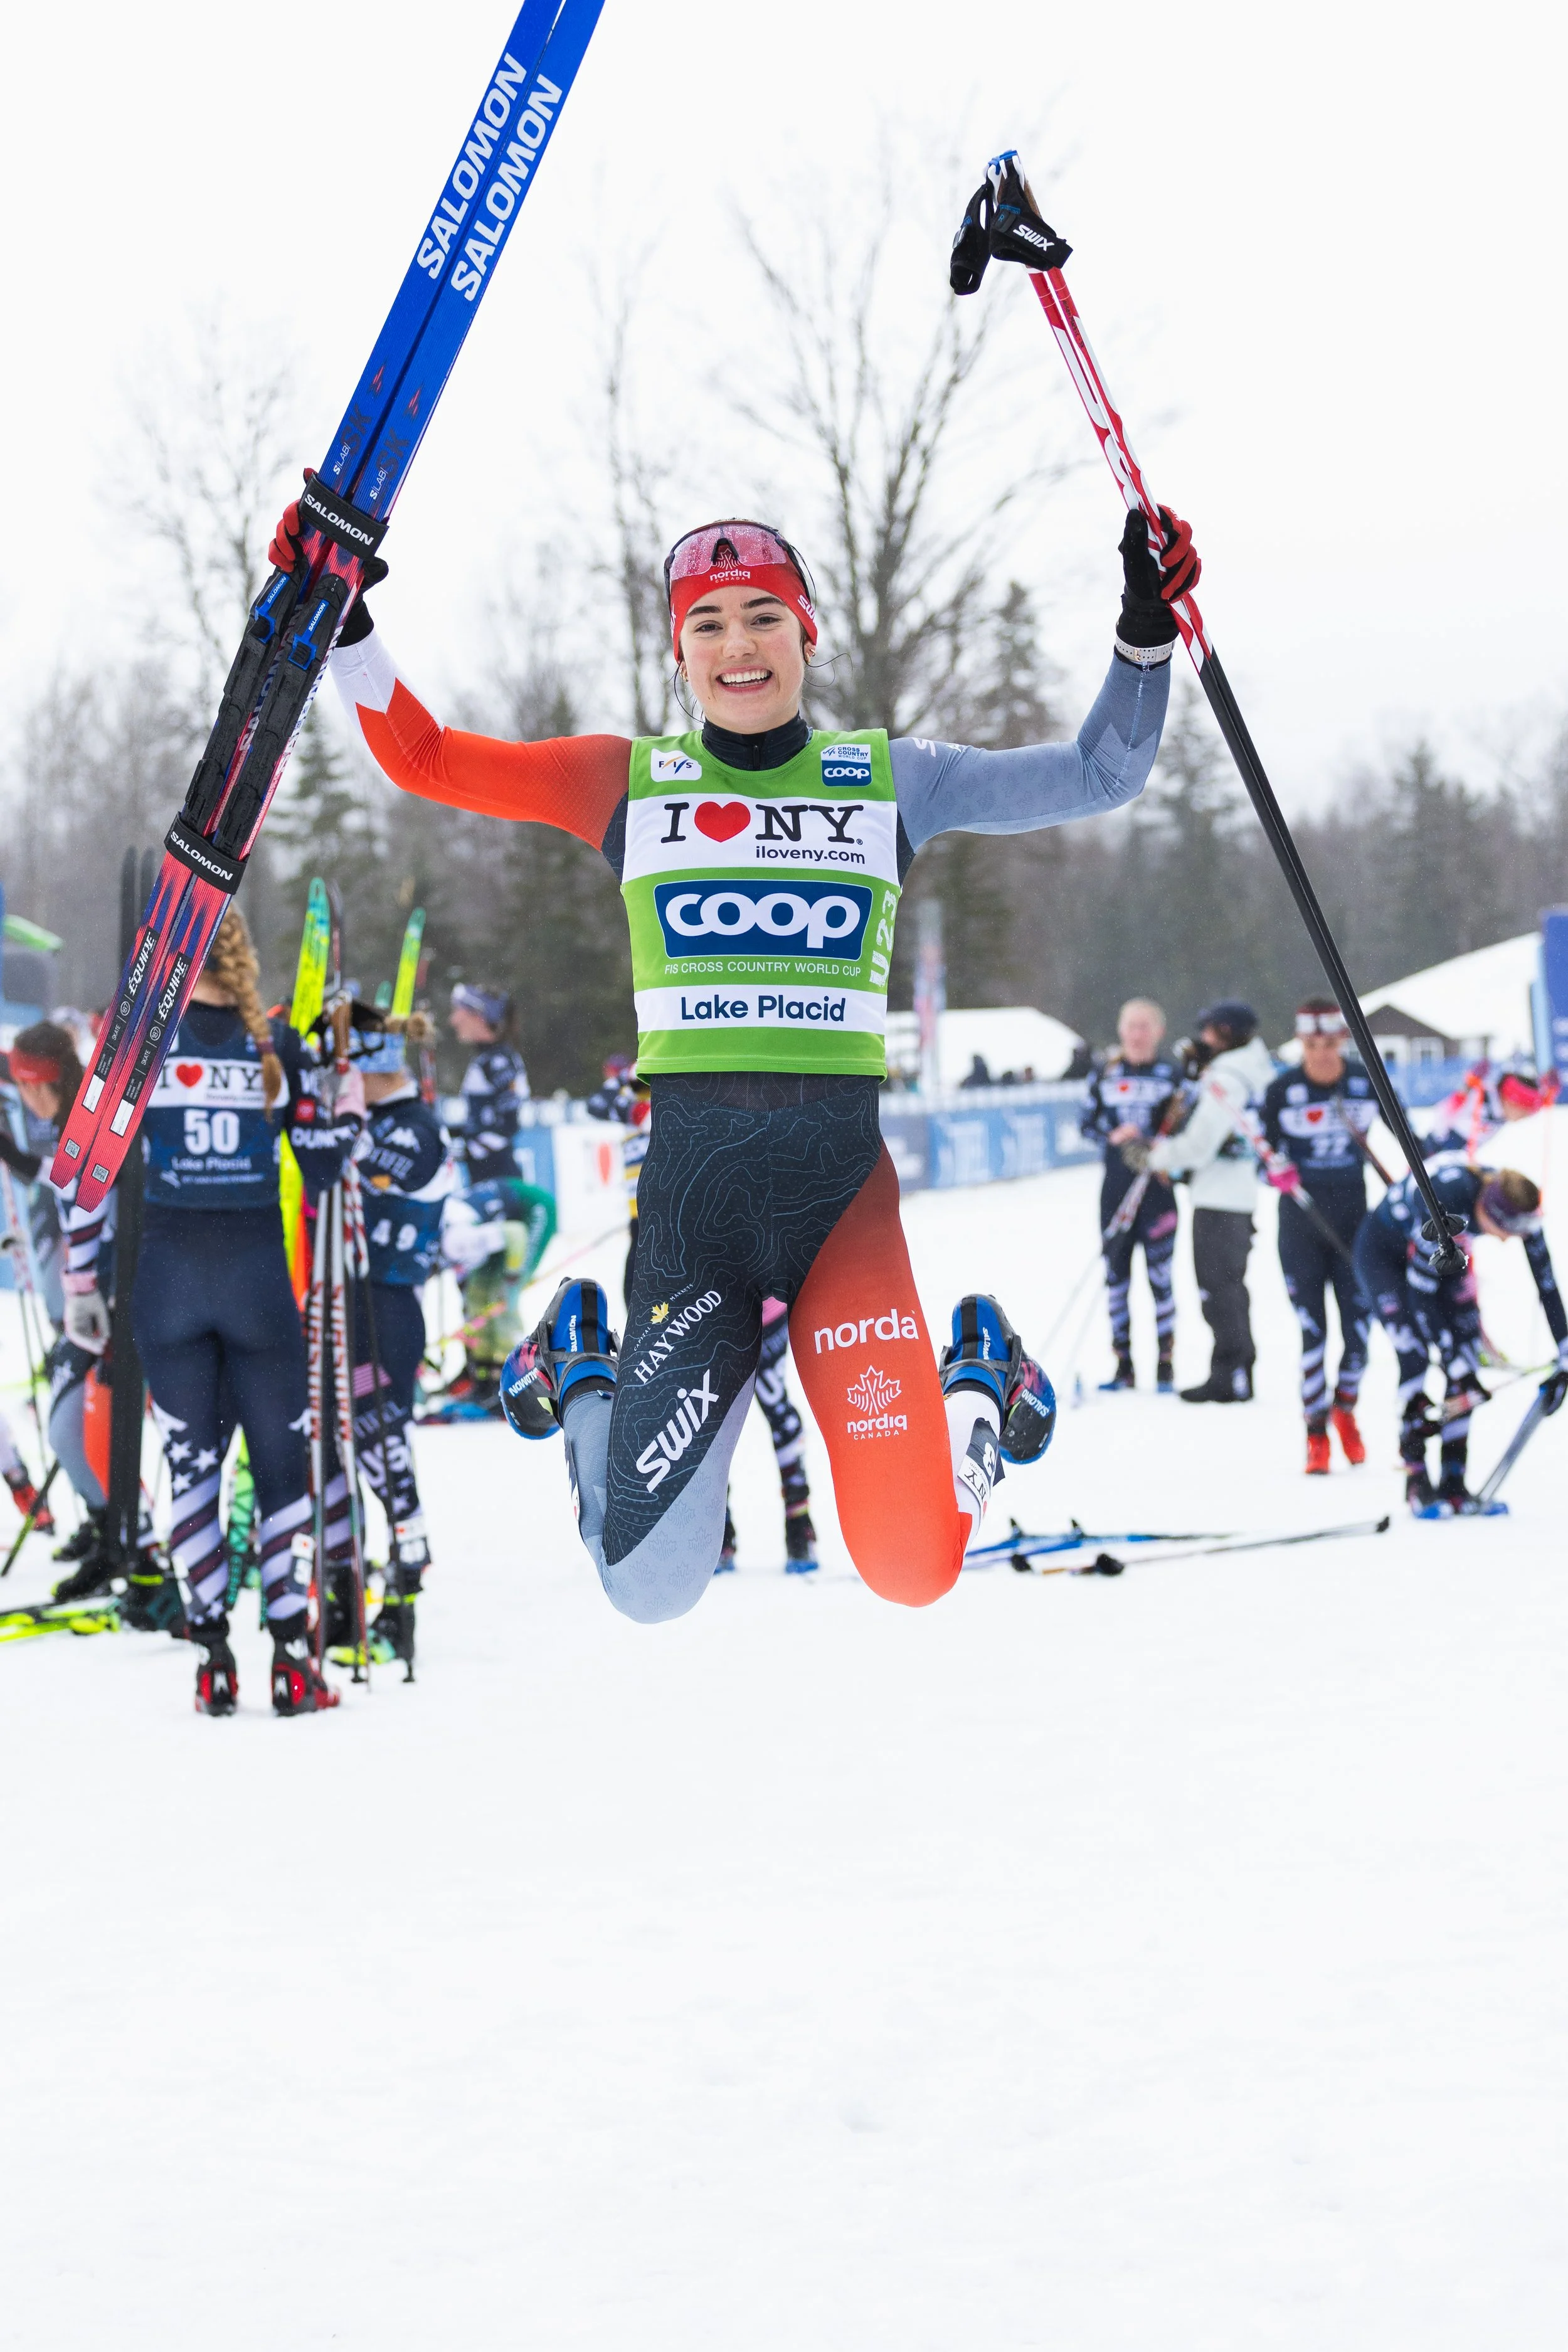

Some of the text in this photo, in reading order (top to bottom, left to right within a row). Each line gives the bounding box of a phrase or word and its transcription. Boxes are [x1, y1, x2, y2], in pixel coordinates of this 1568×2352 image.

[416, 52, 527, 279] SALOMON
[450, 73, 563, 301] SALOMON
[304, 494, 374, 546] SALOMON
[709, 568, 751, 581] nordiq
[267, 576, 287, 604] SALOMON
[308, 602, 326, 632] SALOMON
[824, 767, 870, 779] coop
[660, 802, 690, 844] I
[170, 831, 233, 881] SALOMON
[755, 845, 865, 864] iloveny.com
[665, 892, 861, 949] coop
[665, 961, 861, 977] FIS CROSS COUNTRY WORLD CUP
[681, 995, 847, 1022] Lake Placid
[112, 1024, 121, 1041] SKATE
[141, 1049, 151, 1066] SKATE
[151, 1027, 160, 1040] 187
[208, 1065, 263, 1091] NY
[183, 1108, 240, 1155] 50
[171, 1156, 252, 1171] Lake Placid
[669, 1283, 694, 1301] MARKETS
[633, 1290, 722, 1384] HAYWOOD
[633, 1326, 651, 1351] CAPITAL
[814, 1308, 919, 1355] norda
[508, 1367, 538, 1397] ALOMON
[1021, 1389, 1050, 1417] SALOMO
[847, 1413, 908, 1433] nordiq
[854, 1429, 900, 1440] CANADA
[964, 1469, 987, 1503] NY
